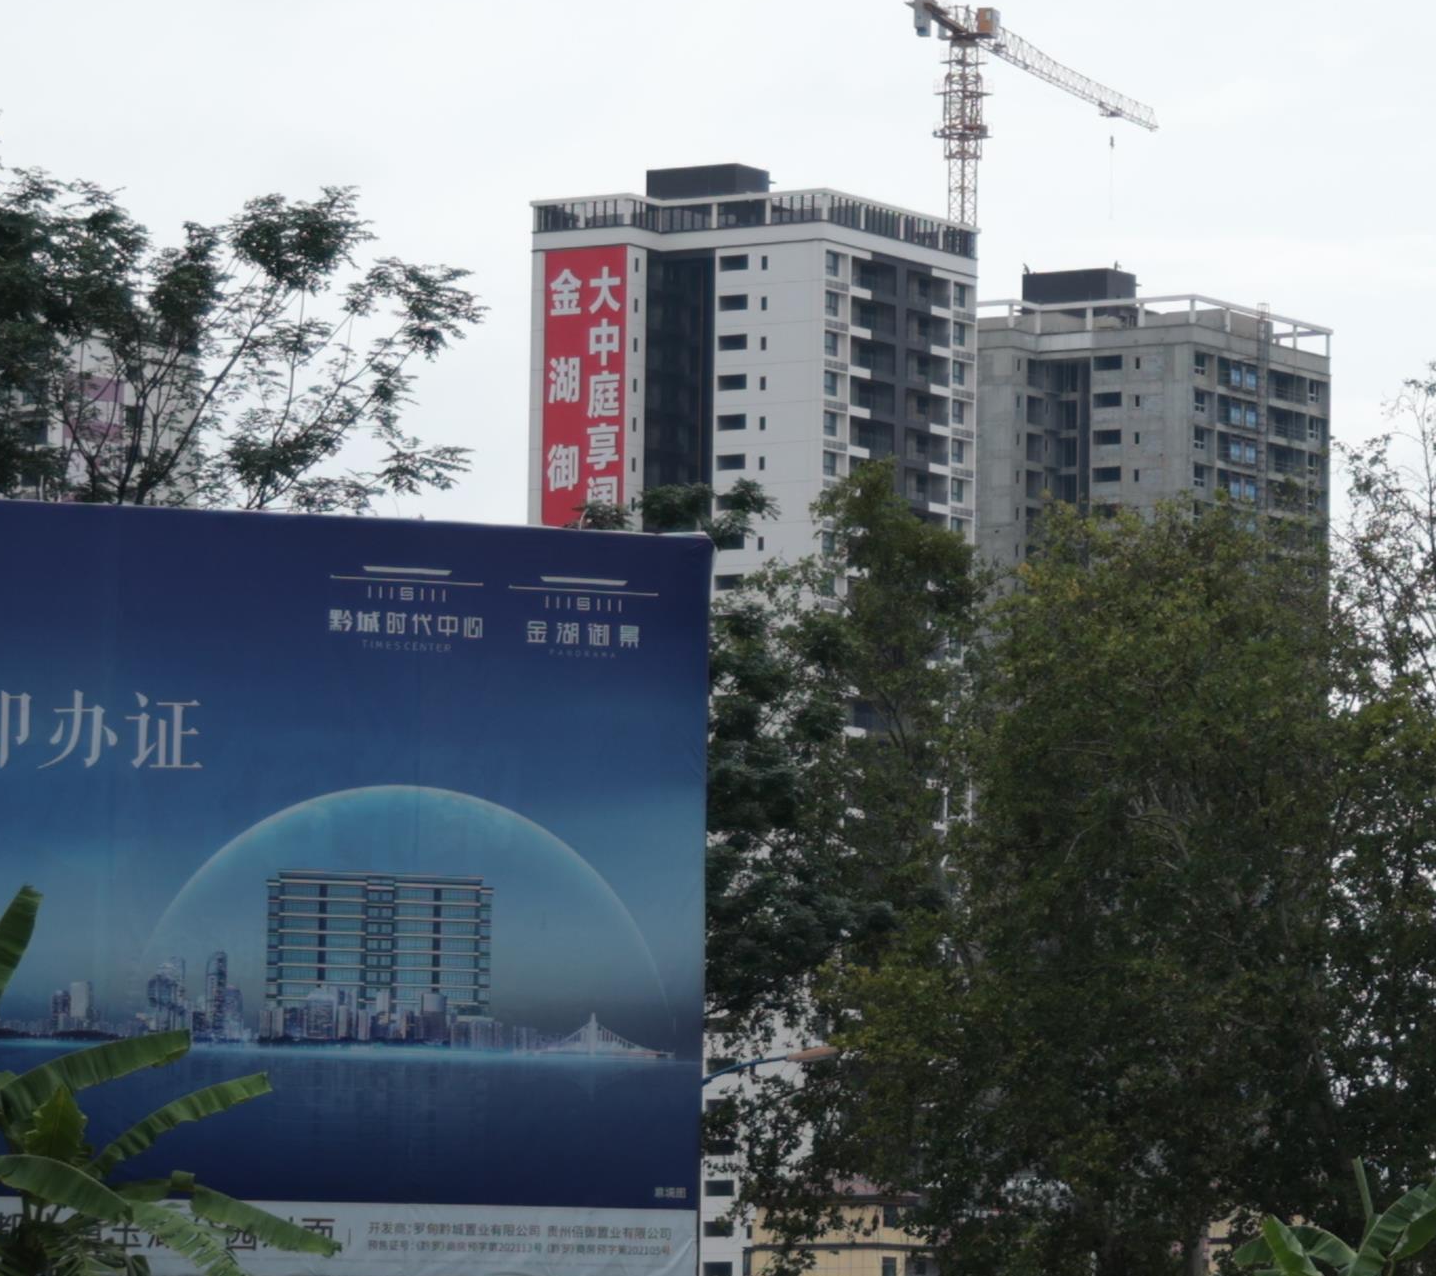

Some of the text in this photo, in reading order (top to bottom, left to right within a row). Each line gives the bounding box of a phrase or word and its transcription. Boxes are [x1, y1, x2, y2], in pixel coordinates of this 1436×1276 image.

[328, 608, 484, 640] 黔城时代中心
[527, 620, 640, 649] 金湖御景
